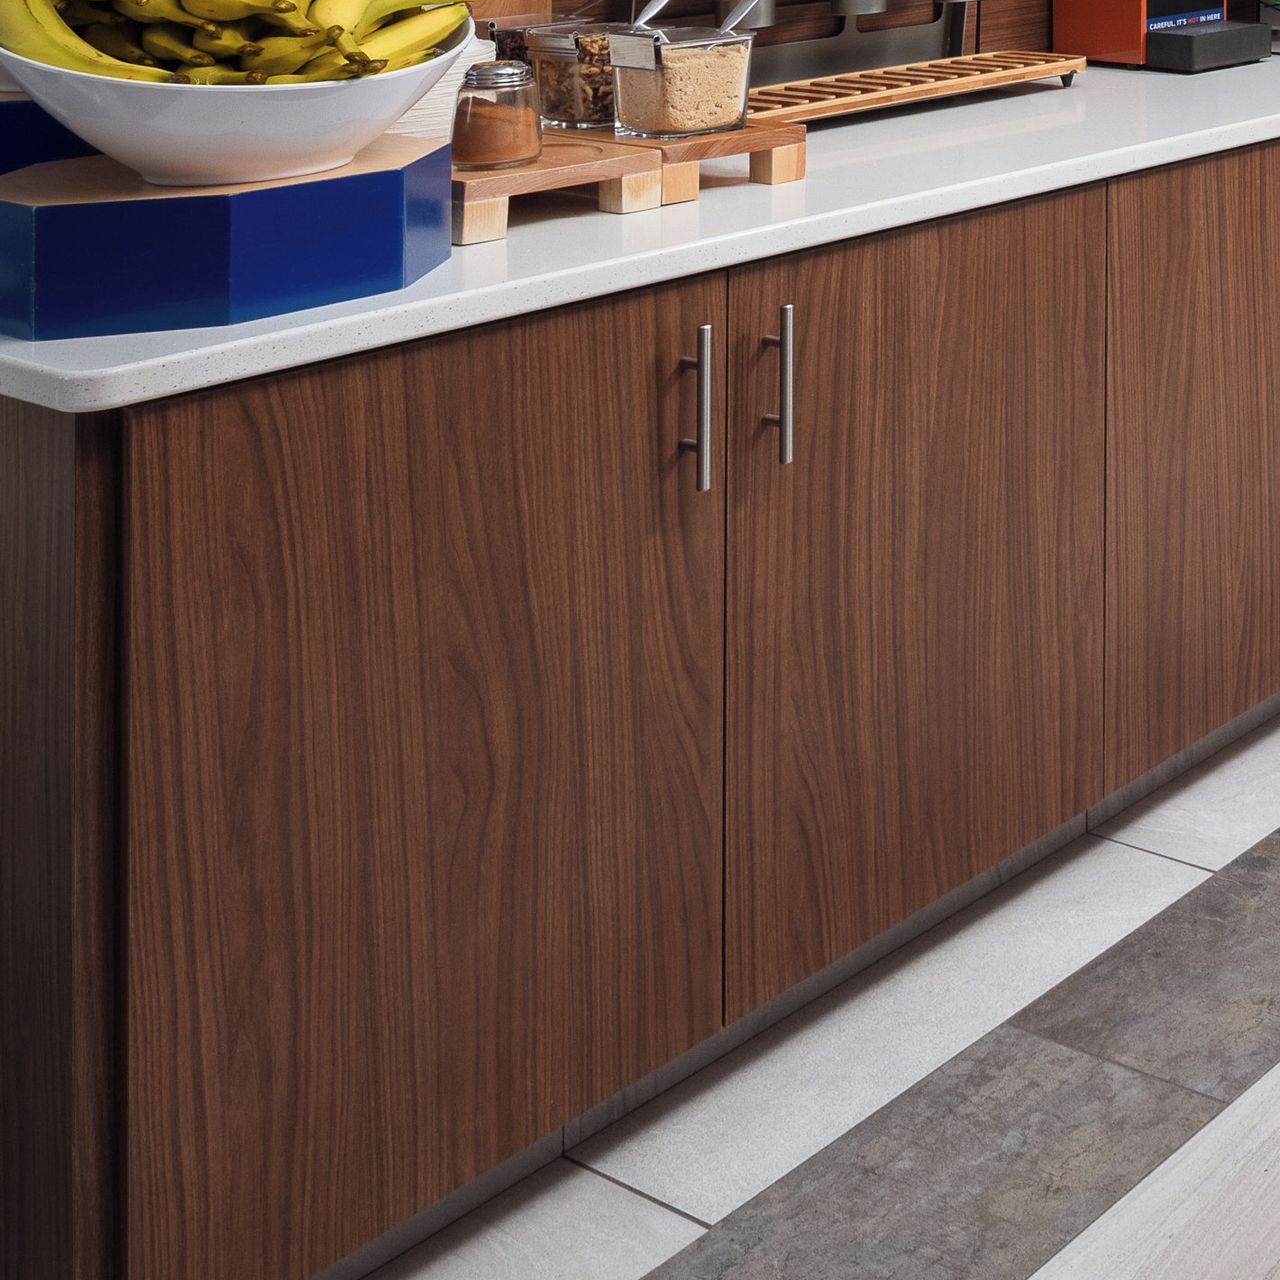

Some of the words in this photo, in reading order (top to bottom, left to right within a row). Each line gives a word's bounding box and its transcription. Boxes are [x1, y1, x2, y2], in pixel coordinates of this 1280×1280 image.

[1176, 18, 1187, 26] IT'S
[1187, 16, 1199, 24] HOT
[1200, 14, 1206, 22] IN
